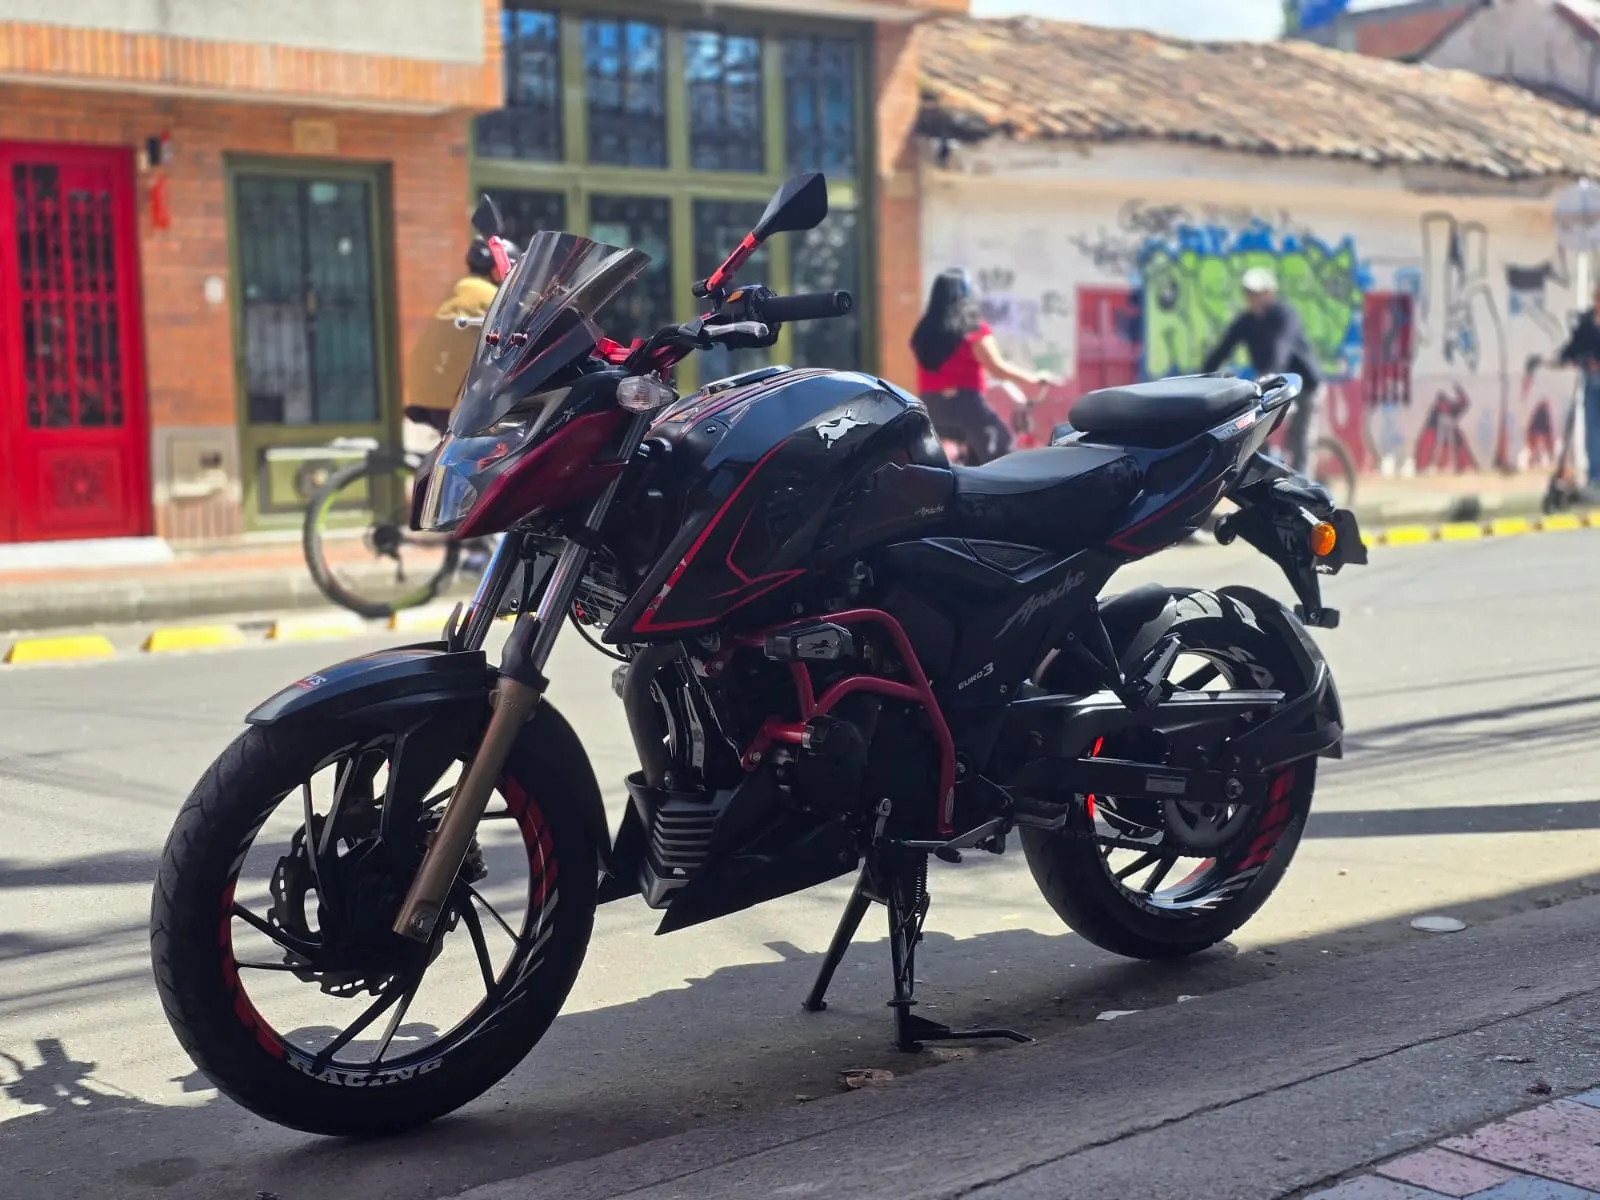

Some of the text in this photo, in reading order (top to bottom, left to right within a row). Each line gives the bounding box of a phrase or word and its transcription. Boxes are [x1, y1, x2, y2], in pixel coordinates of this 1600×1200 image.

[993, 569, 1086, 640] Apache
[957, 661, 995, 690] EURO 3
